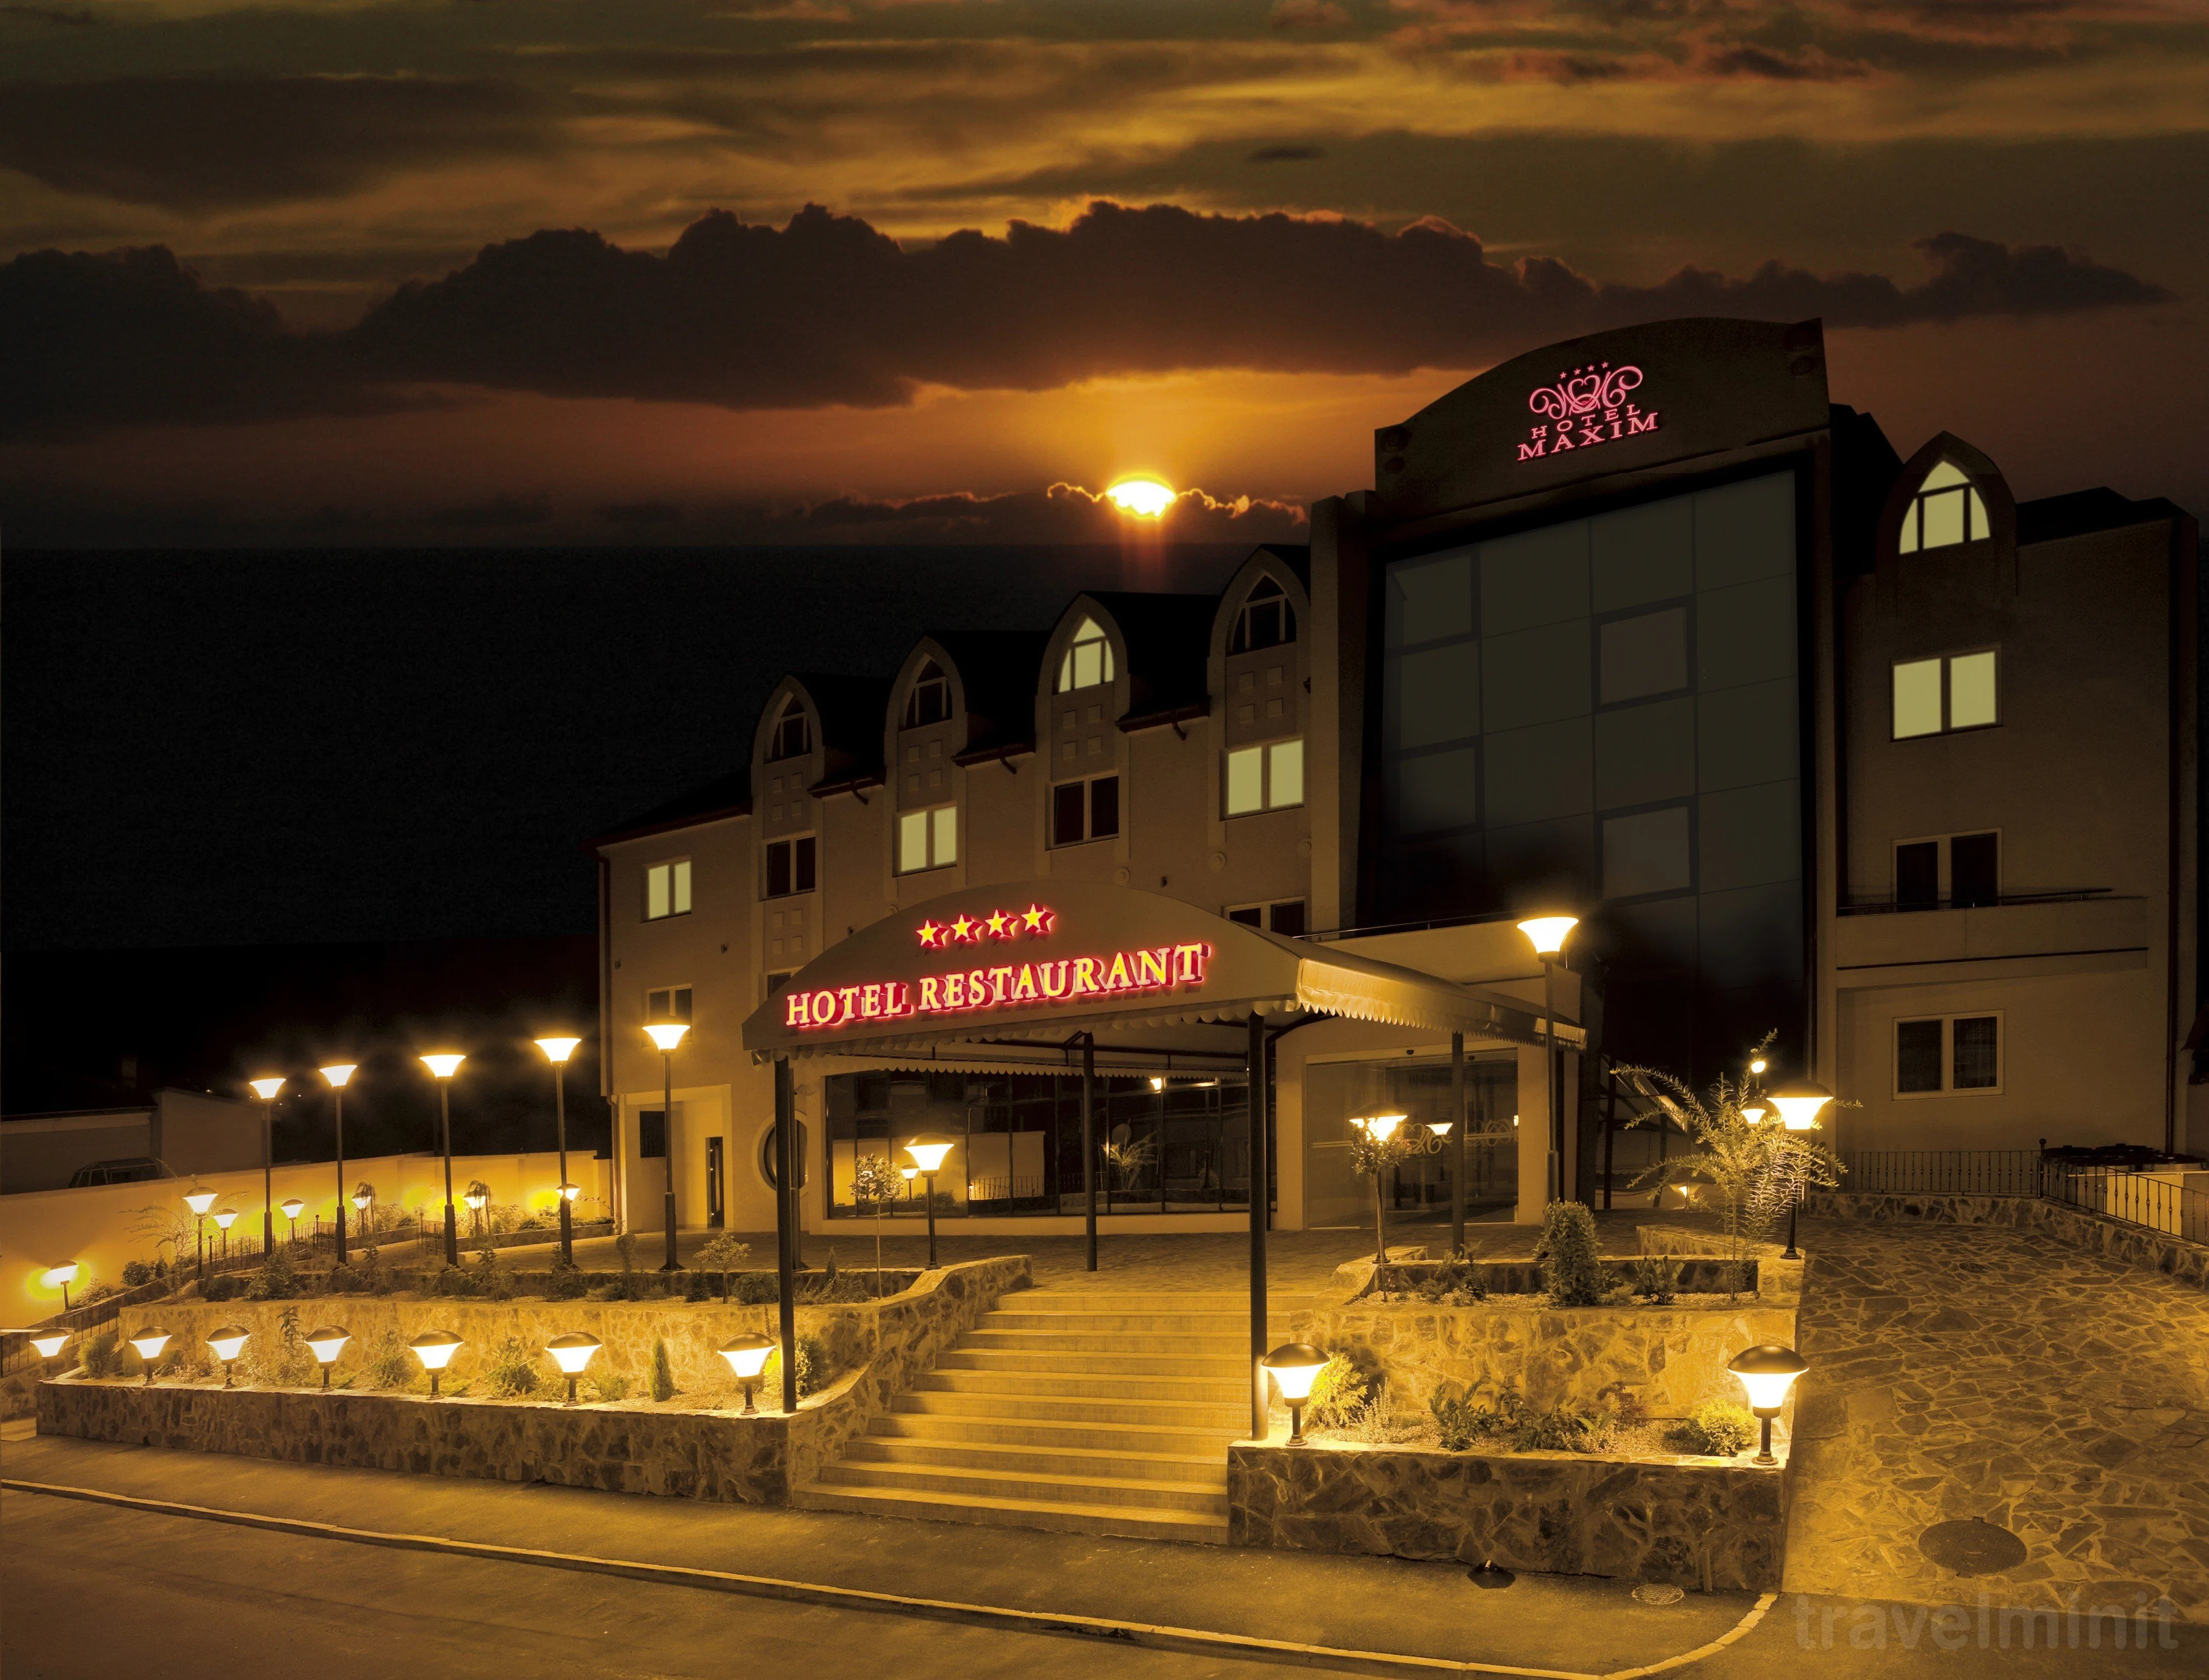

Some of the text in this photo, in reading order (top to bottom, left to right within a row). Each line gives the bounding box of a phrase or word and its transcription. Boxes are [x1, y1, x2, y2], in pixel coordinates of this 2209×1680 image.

[1517, 412, 1658, 460] MAXIM
[1531, 404, 1641, 439] HOTEL
[786, 942, 1203, 1026] HOTEL RESTAURANT
